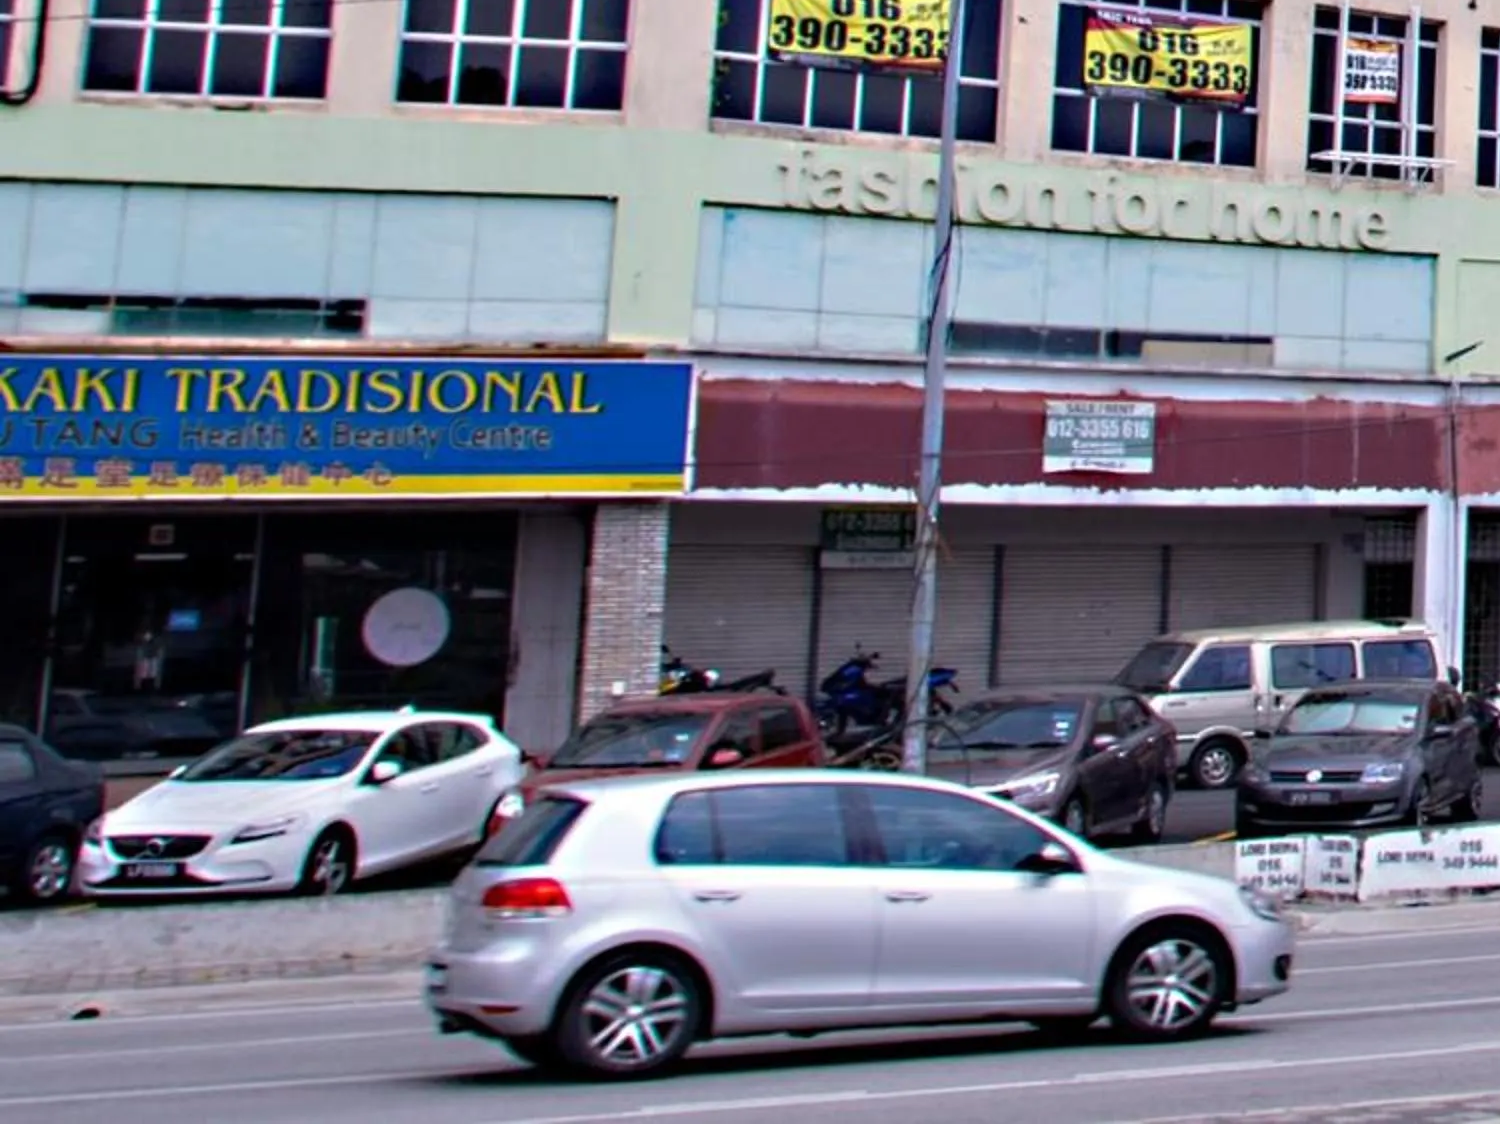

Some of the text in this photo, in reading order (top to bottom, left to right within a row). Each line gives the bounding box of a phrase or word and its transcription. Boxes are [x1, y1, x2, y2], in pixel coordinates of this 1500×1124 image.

[772, 14, 950, 59] 390-3333
[1137, 29, 1200, 56] 016
[1087, 50, 1249, 93] 390-3333
[778, 151, 1394, 251] fashion for home
[165, 368, 605, 414] TRADISIONAL
[30, 419, 160, 449] TANG
[181, 419, 287, 451] Health
[300, 422, 323, 450] &
[332, 421, 442, 460] Beauty
[449, 421, 553, 451] Centre
